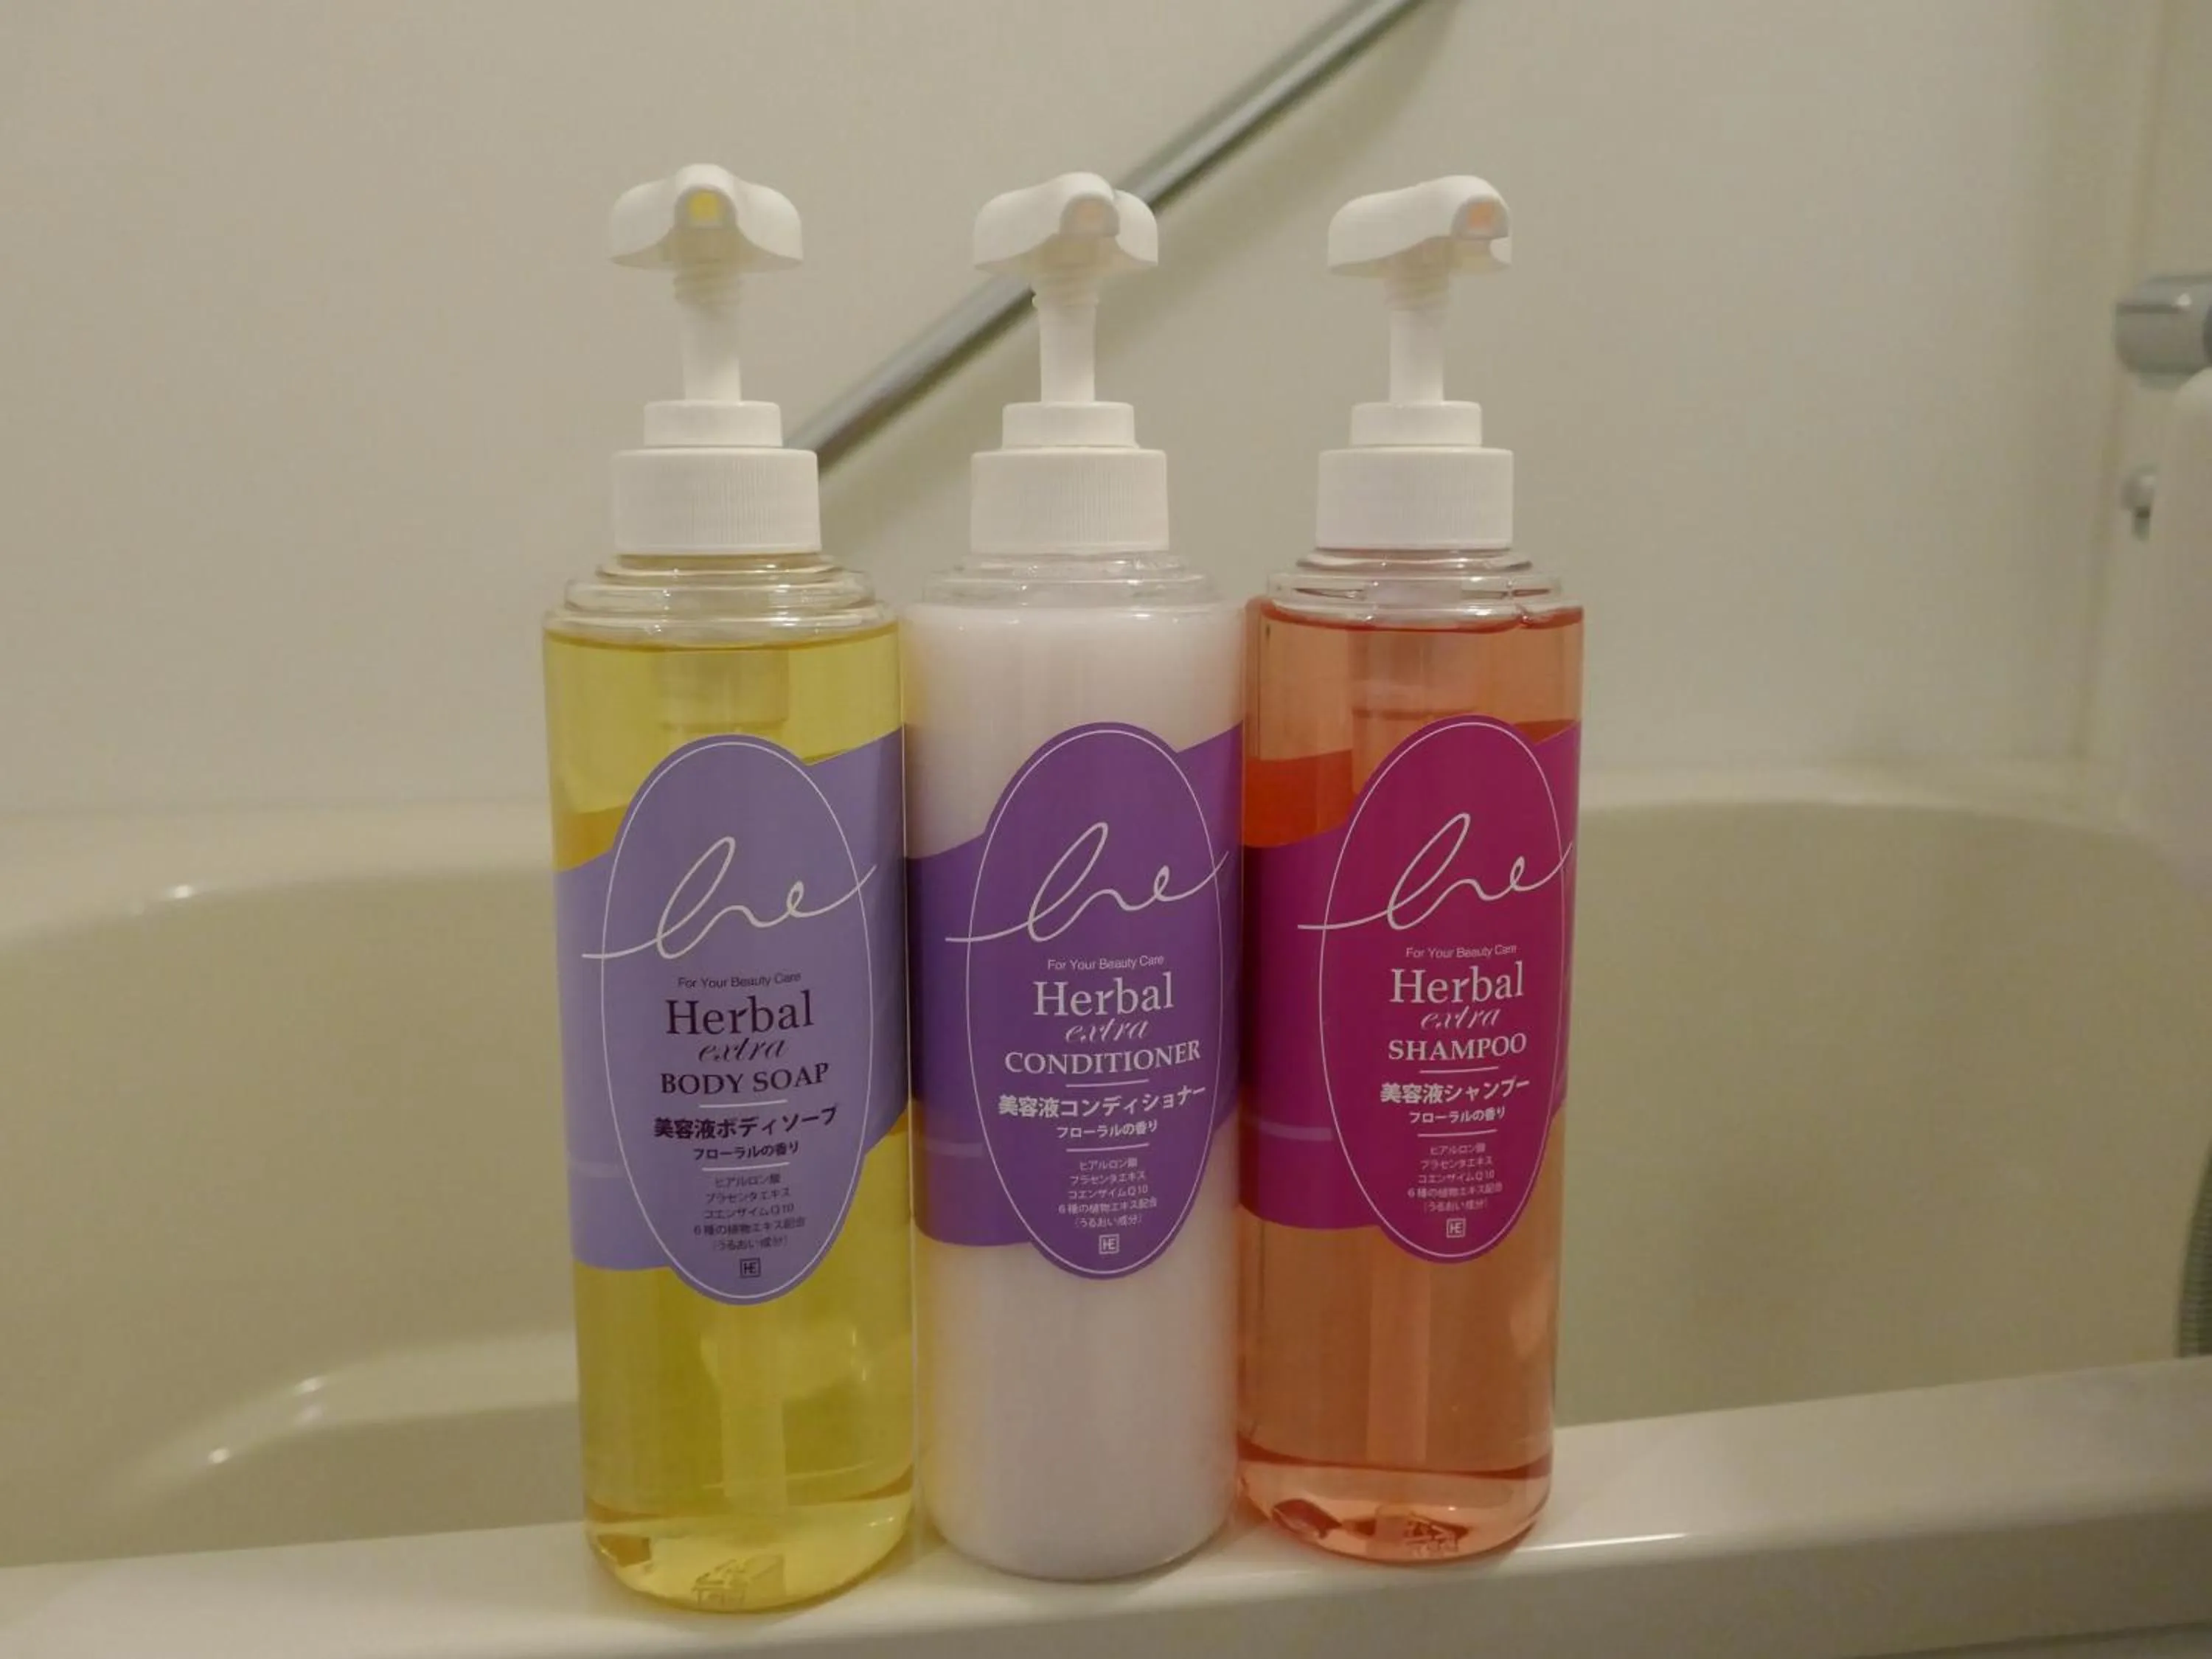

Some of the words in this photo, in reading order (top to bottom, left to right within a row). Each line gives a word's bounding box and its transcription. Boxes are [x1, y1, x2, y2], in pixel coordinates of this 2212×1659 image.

[1048, 960, 1066, 970] For
[1071, 960, 1096, 970] Your
[1099, 958, 1135, 970] Beauty
[1139, 955, 1164, 967] Care
[1406, 947, 1424, 958] For
[1428, 947, 1453, 958] Your
[1456, 946, 1492, 958] Beauty
[1495, 944, 1517, 955] Care
[678, 977, 697, 988] For
[702, 978, 727, 988] Your
[731, 976, 771, 988] Beauty
[774, 972, 801, 984] Care
[1389, 960, 1524, 1004] Herbal
[1033, 971, 1175, 1017] Herbal
[665, 990, 814, 1034] Herbal
[1420, 1005, 1501, 1030] extra
[1065, 1018, 1149, 1043] extra
[698, 1037, 786, 1062] extra
[1005, 1040, 1201, 1075] CONDITIONER
[1388, 1033, 1527, 1060] SHAMPOO
[661, 1074, 743, 1094] BODY
[752, 1062, 829, 1092] SOAP
[1380, 1076, 1530, 1105] 美容液シャンプー
[998, 1085, 1206, 1119] 美容液コンディショナー
[1409, 1106, 1506, 1124] フローラルの香り
[653, 1105, 838, 1140] 美容液ボディソープ
[1057, 1120, 1158, 1138] フローラルの香り
[693, 1141, 799, 1161] フローラルの香り
